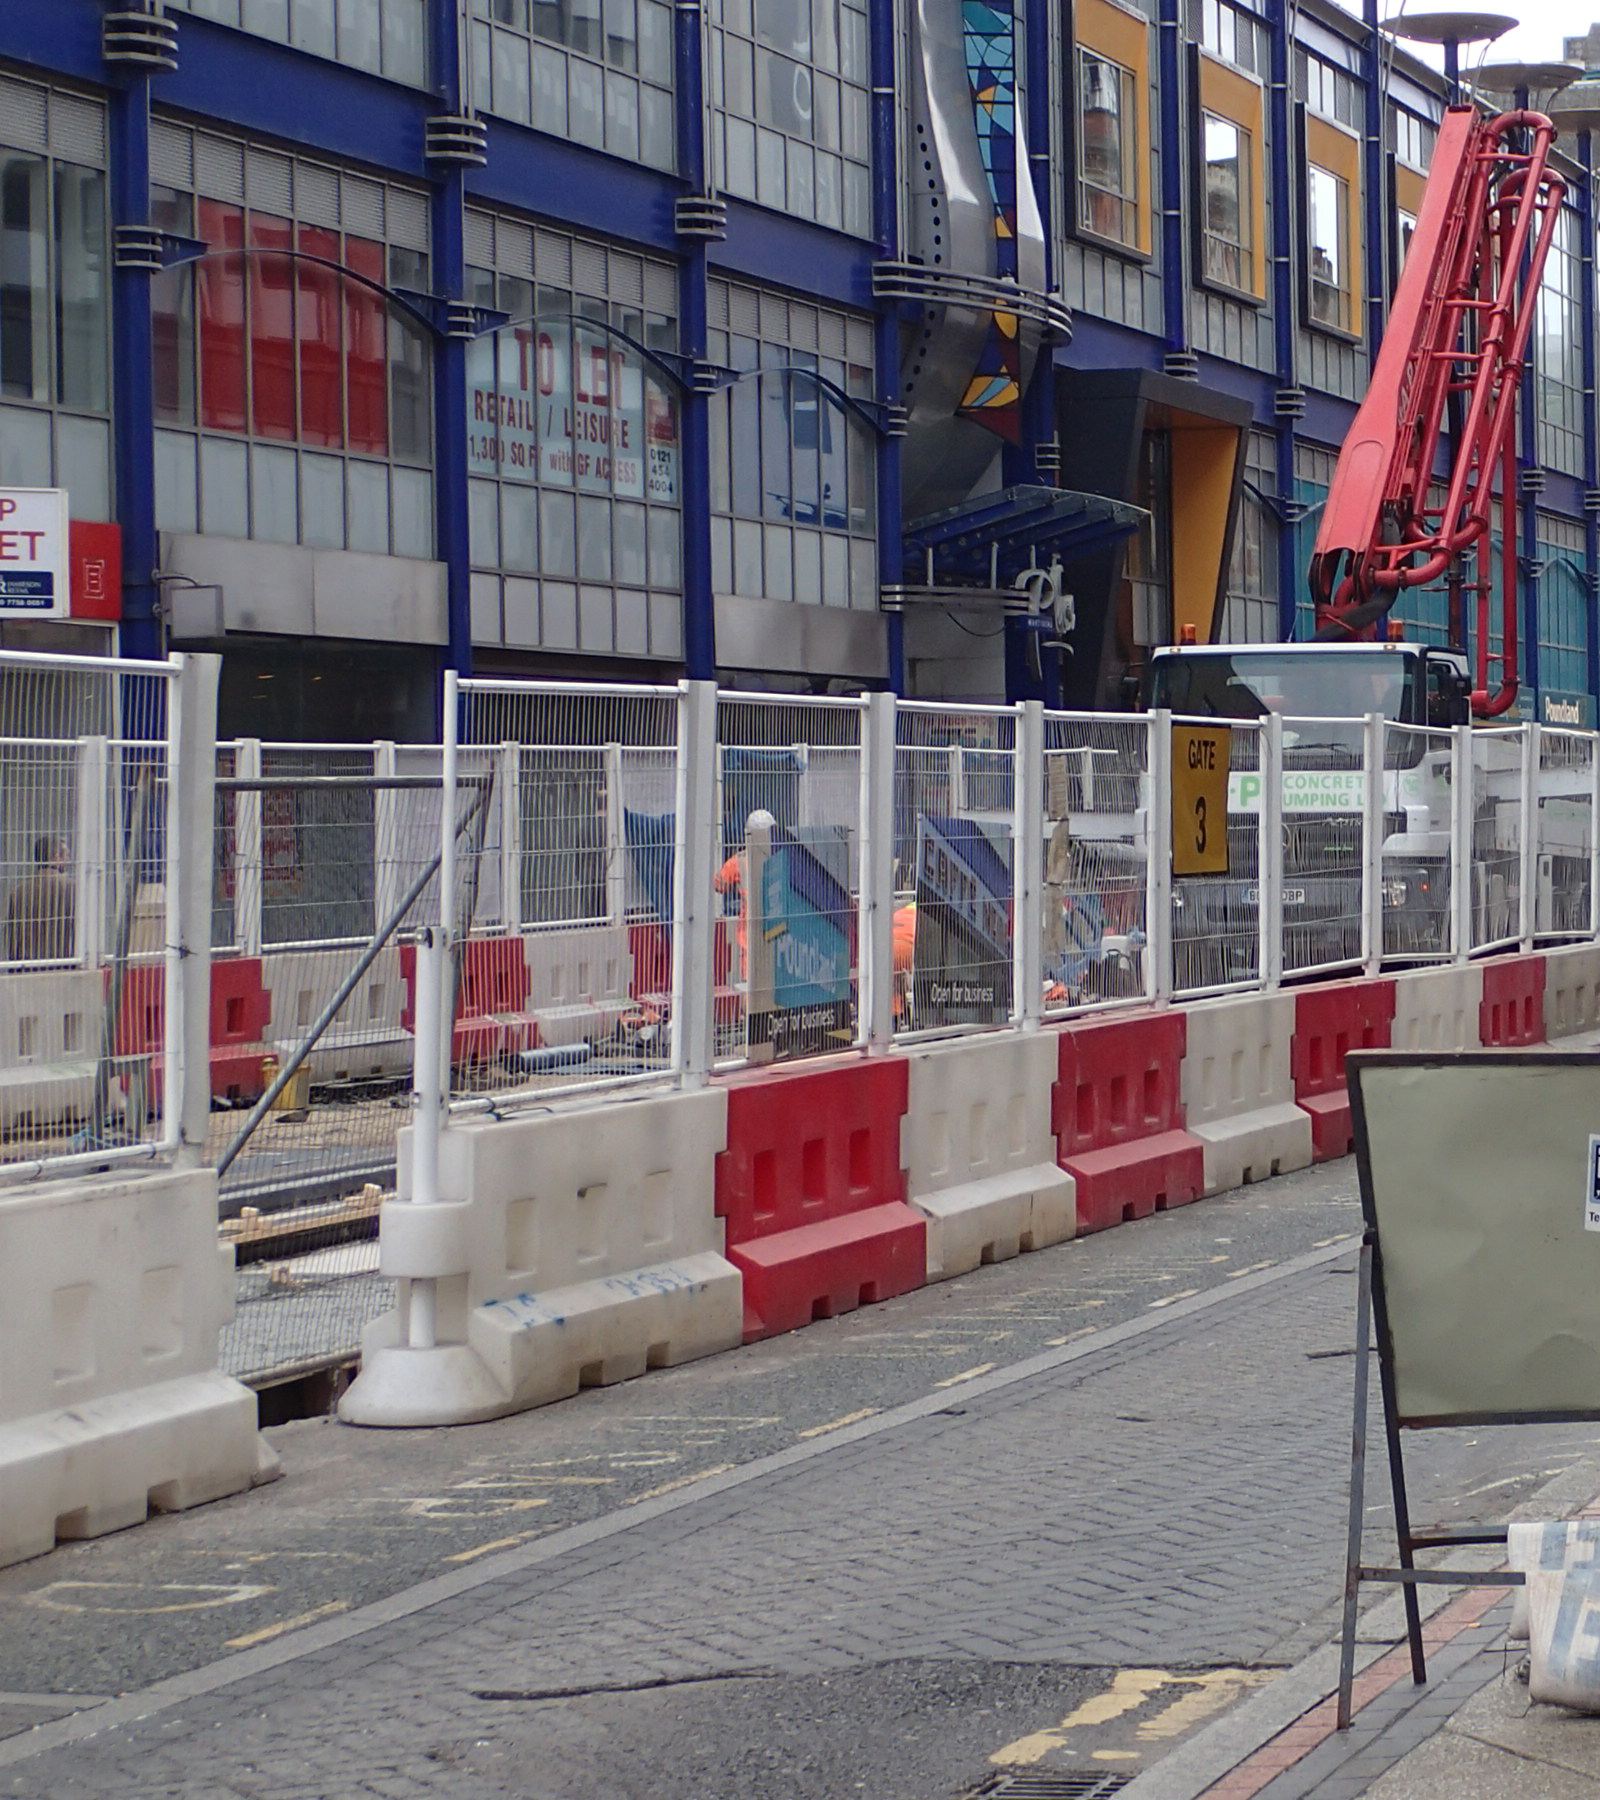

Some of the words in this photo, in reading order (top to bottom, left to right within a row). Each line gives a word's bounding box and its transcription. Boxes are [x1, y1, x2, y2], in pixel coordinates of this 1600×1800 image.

[514, 327, 555, 396] TO
[574, 340, 626, 410] LET
[474, 388, 534, 431] RETAIL
[563, 406, 630, 449] LEISURE
[511, 442, 525, 468] SQ
[550, 449, 574, 474] with
[577, 453, 590, 477] GF
[650, 449, 672, 464] 0121
[651, 465, 671, 477] 454
[1545, 695, 1580, 725] Poundland
[1187, 739, 1217, 770] GATE
[1283, 775, 1365, 790] CONCRET
[1282, 792, 1350, 807] UMPING
[1194, 796, 1207, 855] 3
[932, 983, 950, 1004] Open
[951, 980, 963, 1001] for
[965, 981, 994, 1002] business
[767, 1013, 788, 1037] Open
[789, 1009, 801, 1030] for
[802, 1004, 835, 1029] business
